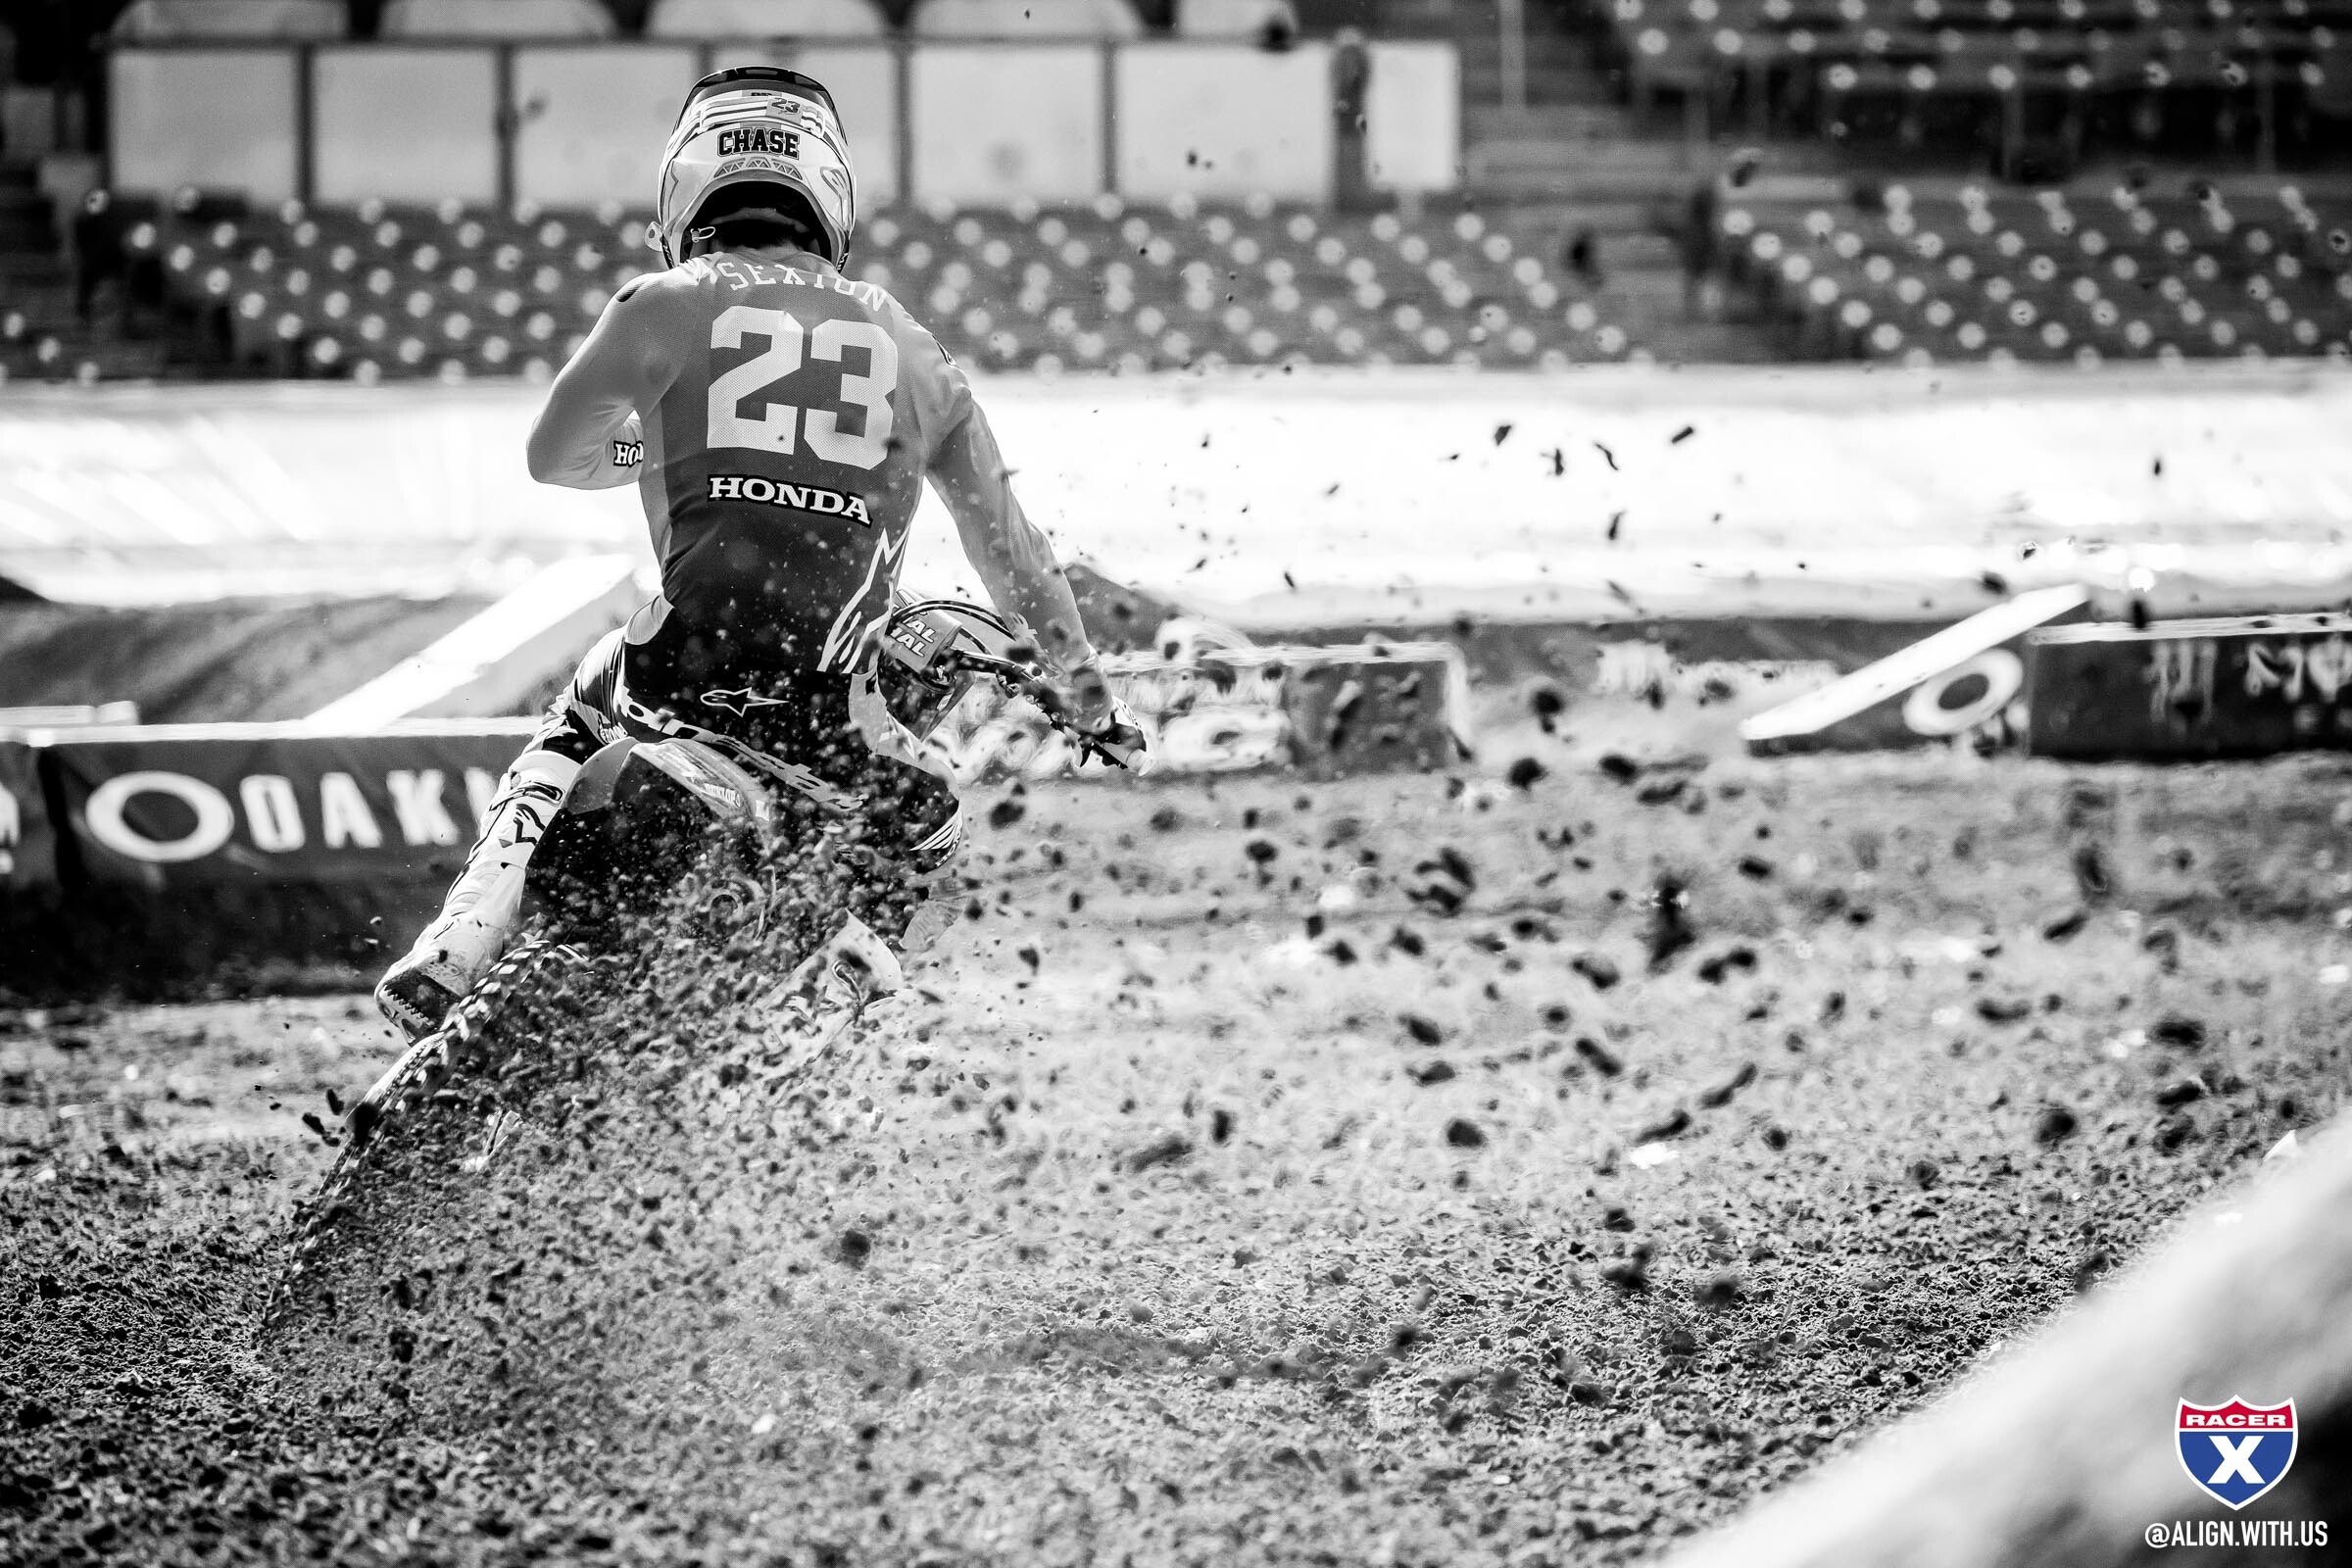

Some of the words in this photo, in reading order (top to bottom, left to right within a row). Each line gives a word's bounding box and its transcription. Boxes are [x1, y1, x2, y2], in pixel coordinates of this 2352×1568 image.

[717, 127, 801, 160] CHASE
[707, 306, 899, 470] 23
[708, 476, 871, 525] HONDA
